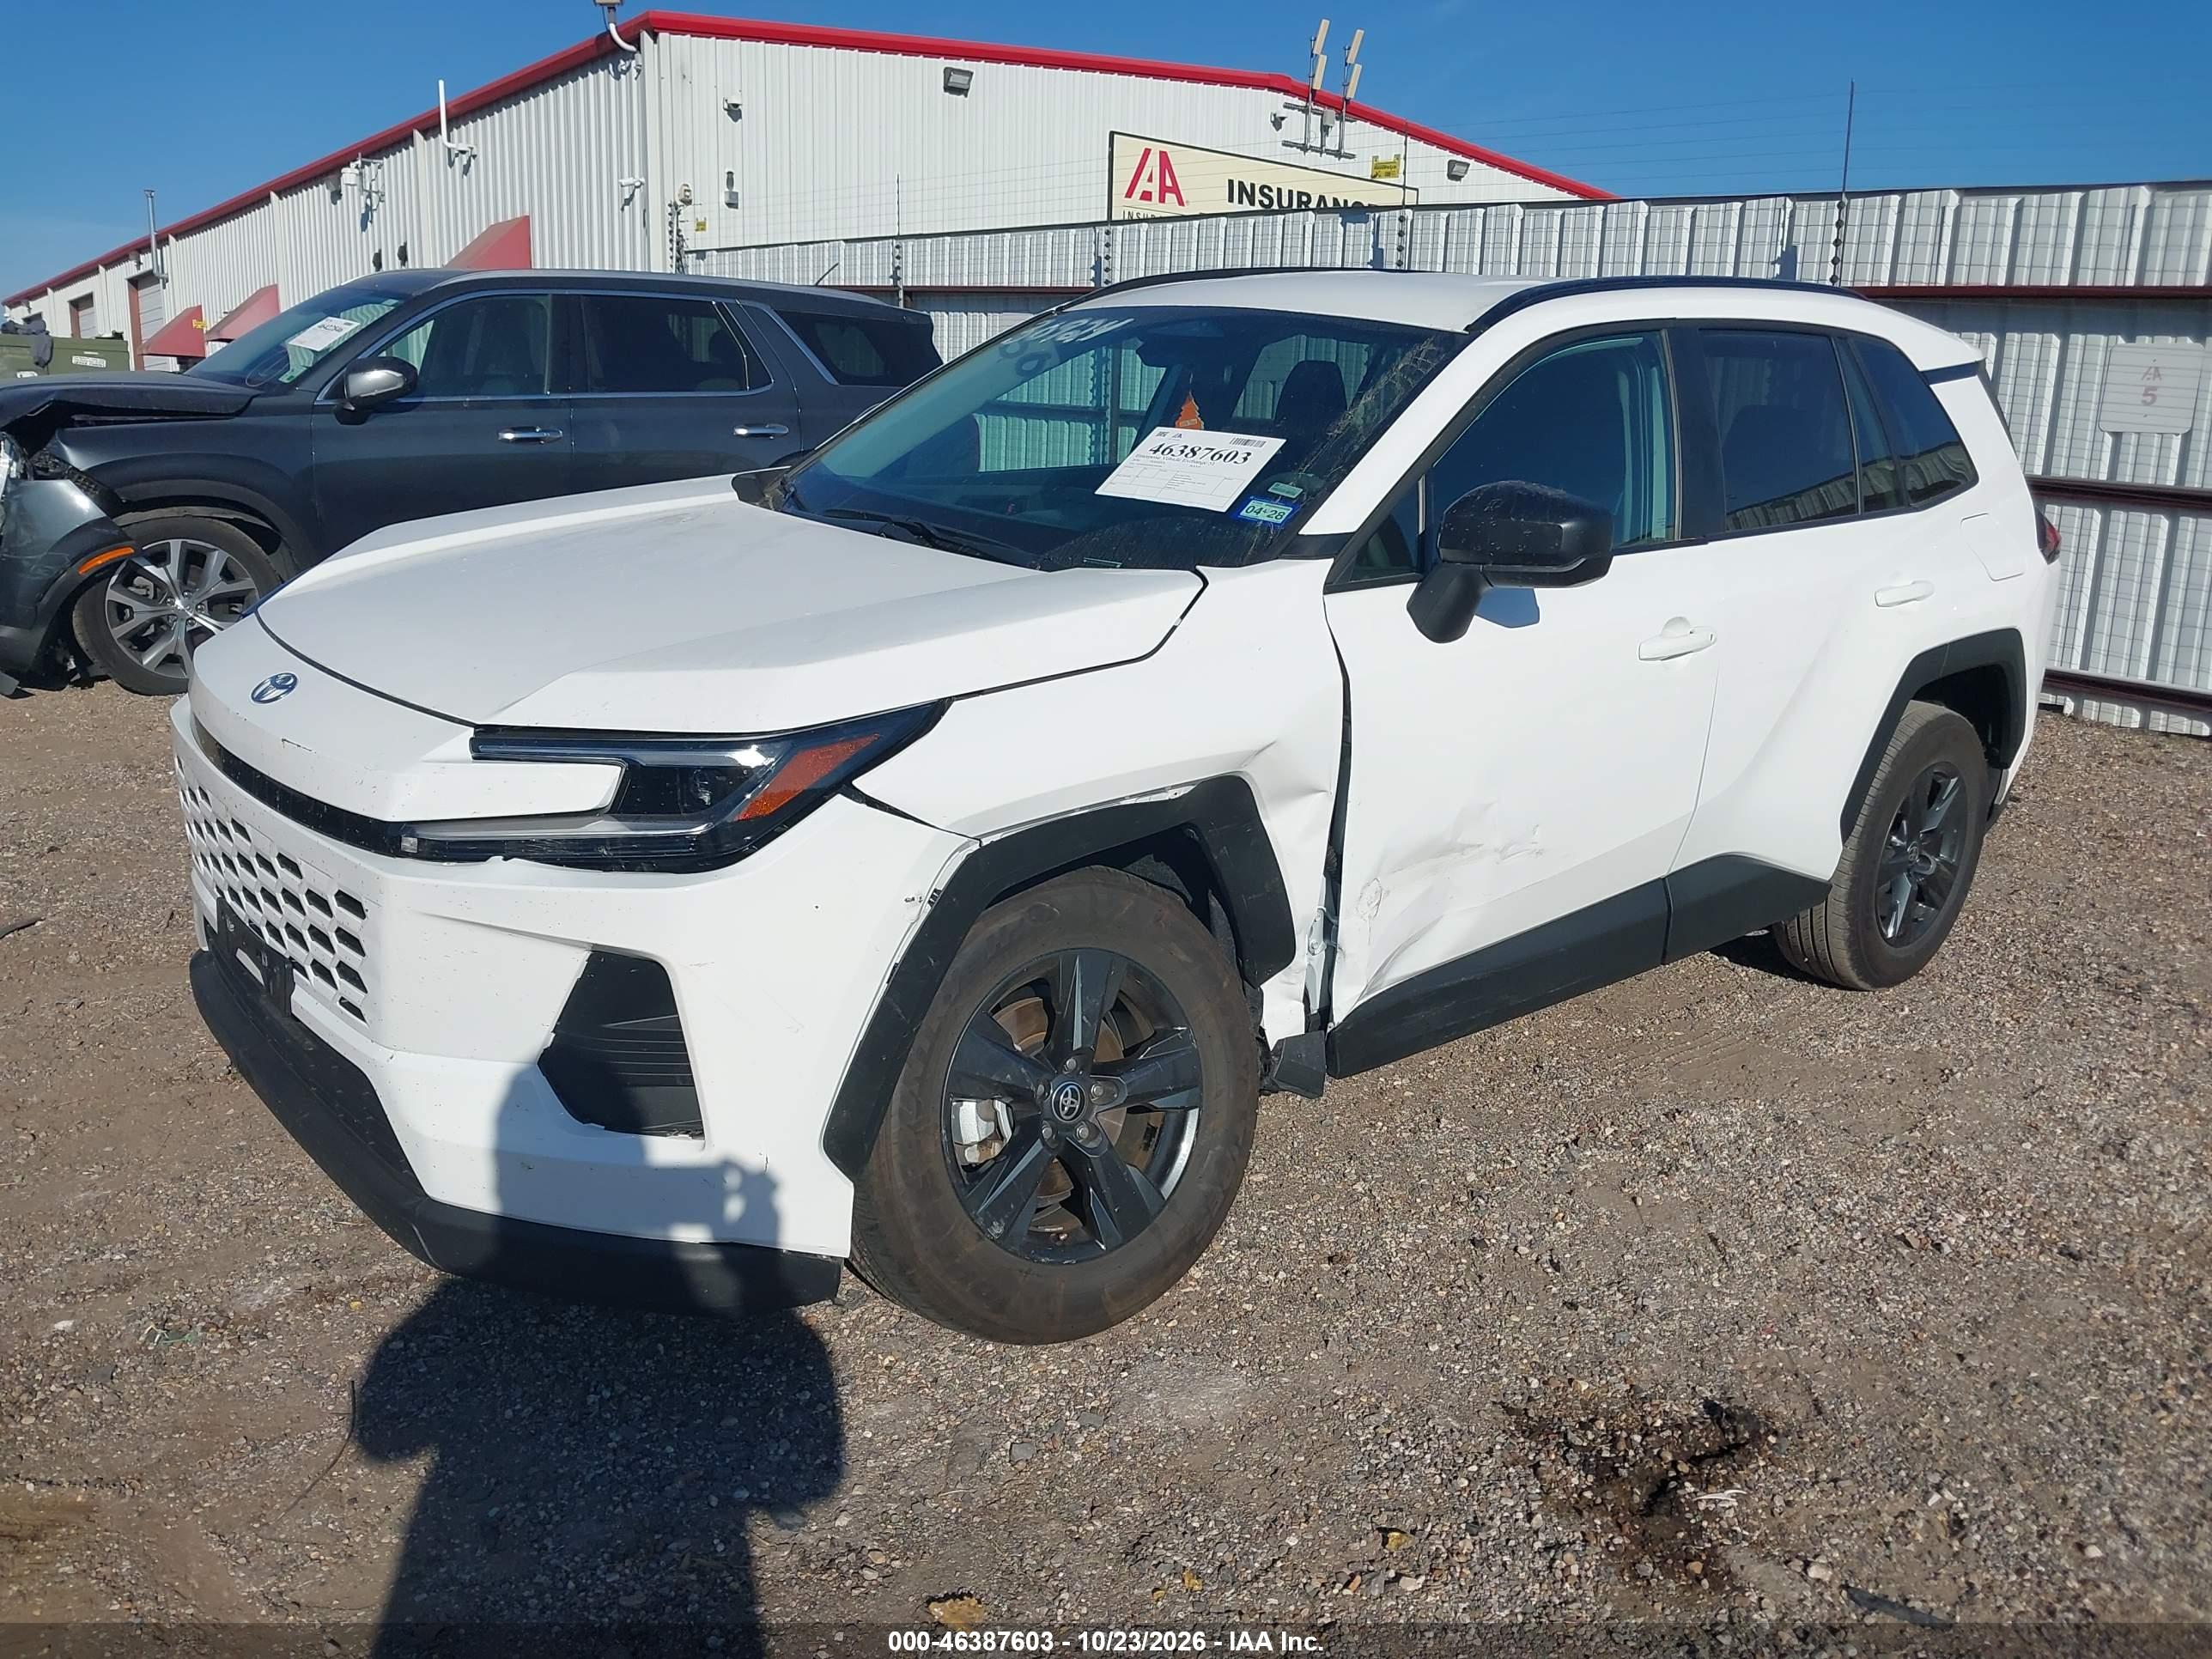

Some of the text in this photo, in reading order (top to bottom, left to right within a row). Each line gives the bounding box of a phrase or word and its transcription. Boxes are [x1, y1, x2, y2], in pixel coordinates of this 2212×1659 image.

[1227, 179, 1379, 210] INSURA
[2142, 386, 2157, 406] 5
[1148, 442, 1252, 465] 46387603
[1245, 505, 1263, 515] 04
[1267, 509, 1285, 520] 28
